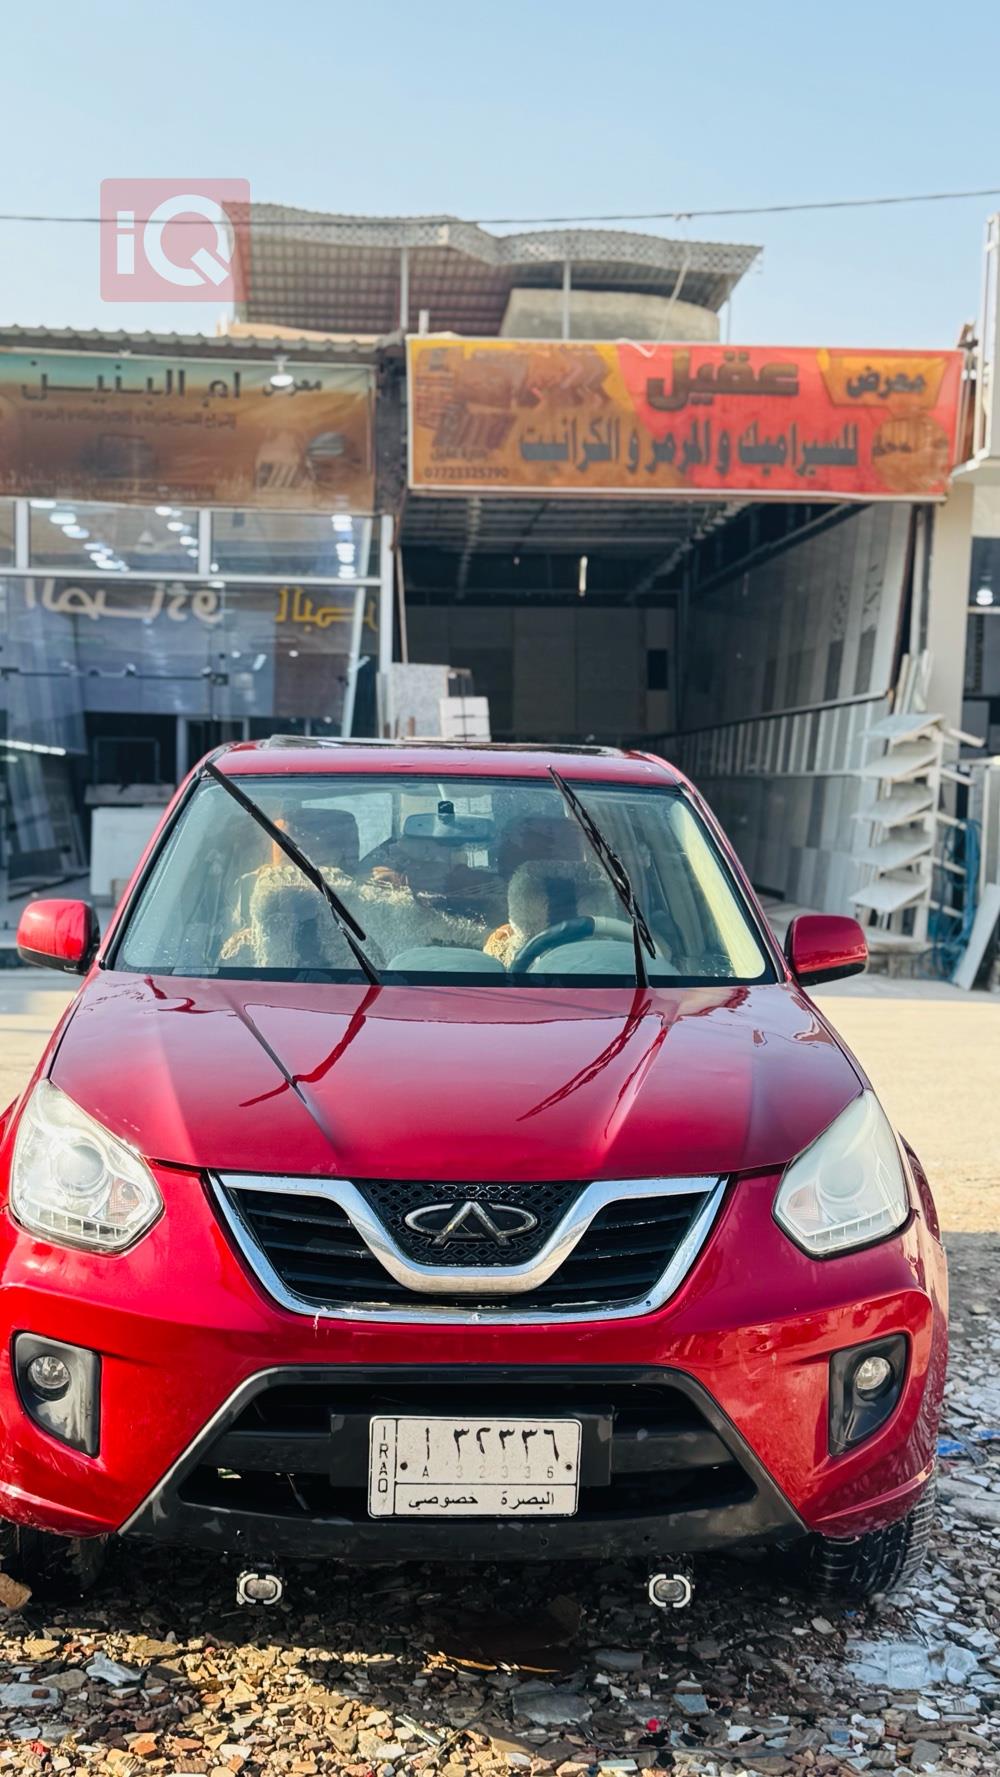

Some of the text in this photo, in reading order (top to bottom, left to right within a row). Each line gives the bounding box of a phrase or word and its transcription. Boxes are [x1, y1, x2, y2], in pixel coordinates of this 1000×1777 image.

[646, 348, 927, 411] معرض عقيل
[408, 1490, 555, 1511] البصرة خصوصي
